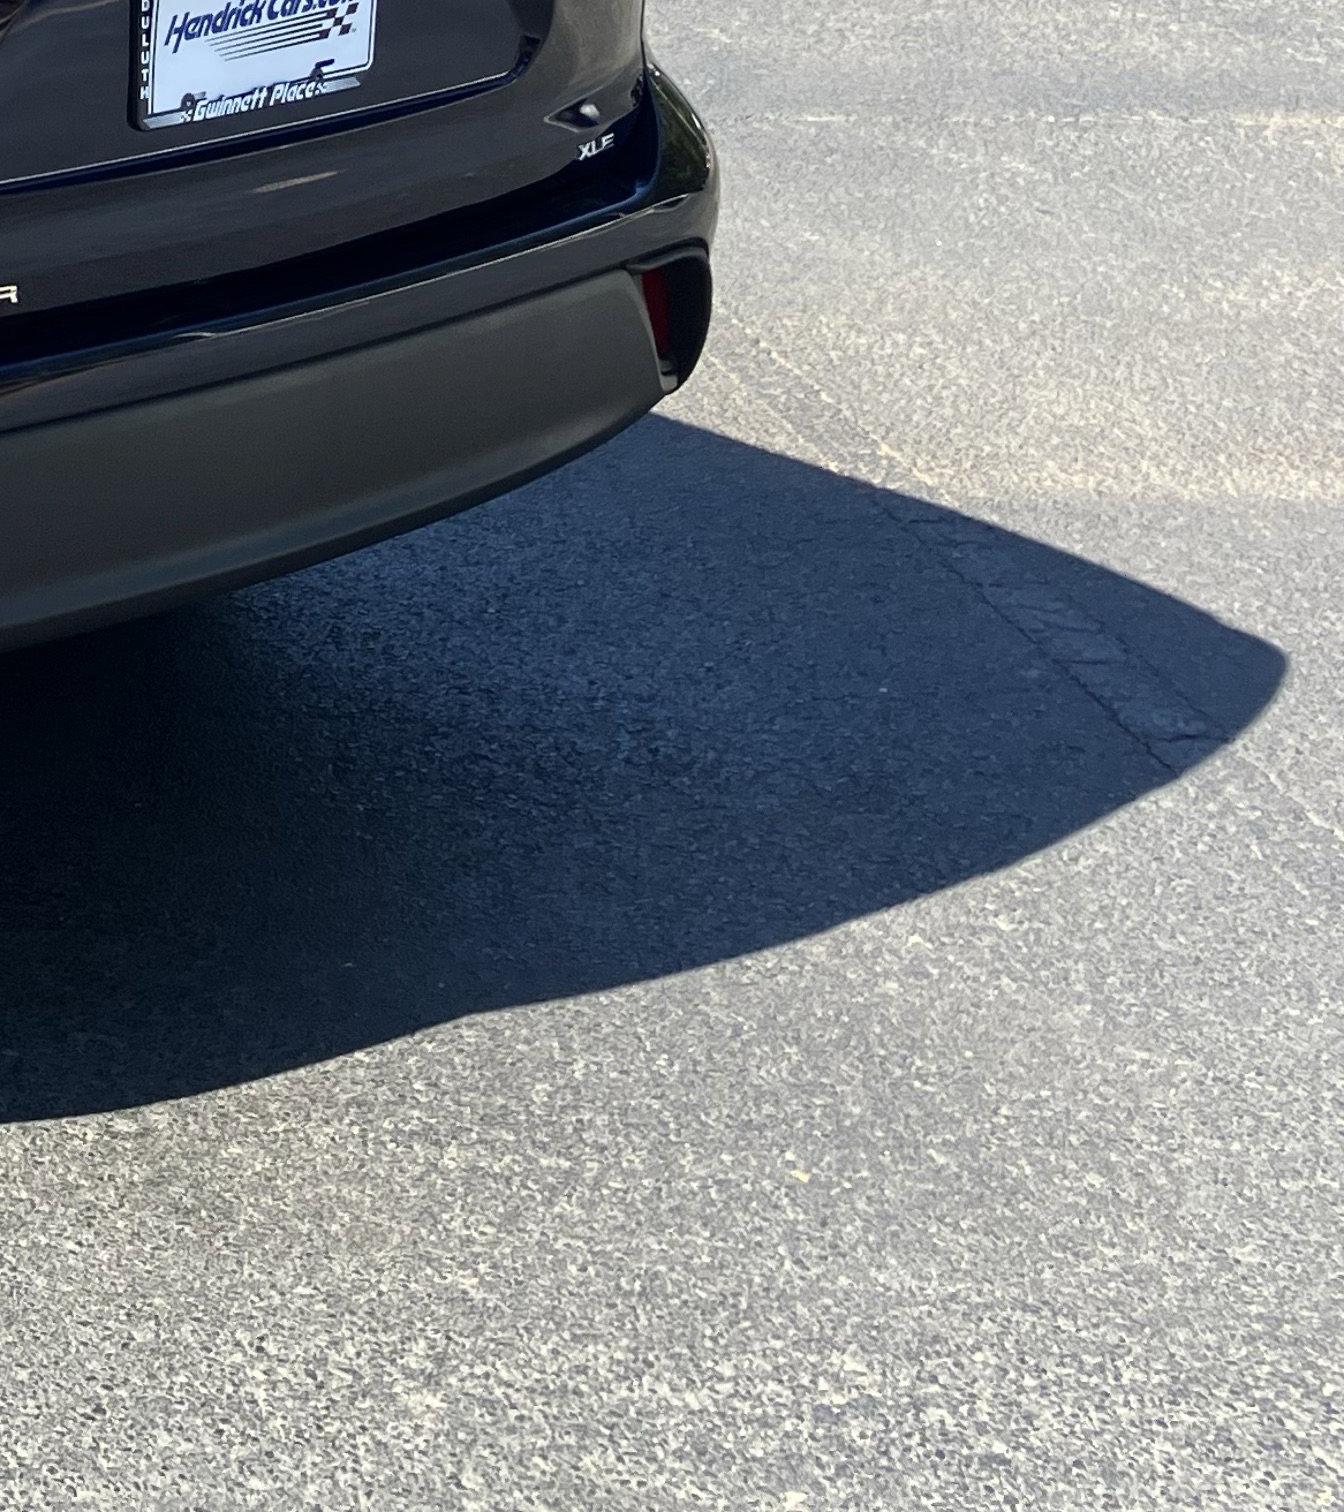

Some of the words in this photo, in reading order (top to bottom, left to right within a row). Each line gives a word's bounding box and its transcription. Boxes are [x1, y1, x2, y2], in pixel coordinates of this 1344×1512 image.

[194, 86, 269, 121] Gwinnett
[269, 80, 316, 106] Place
[578, 133, 614, 161] XLE
